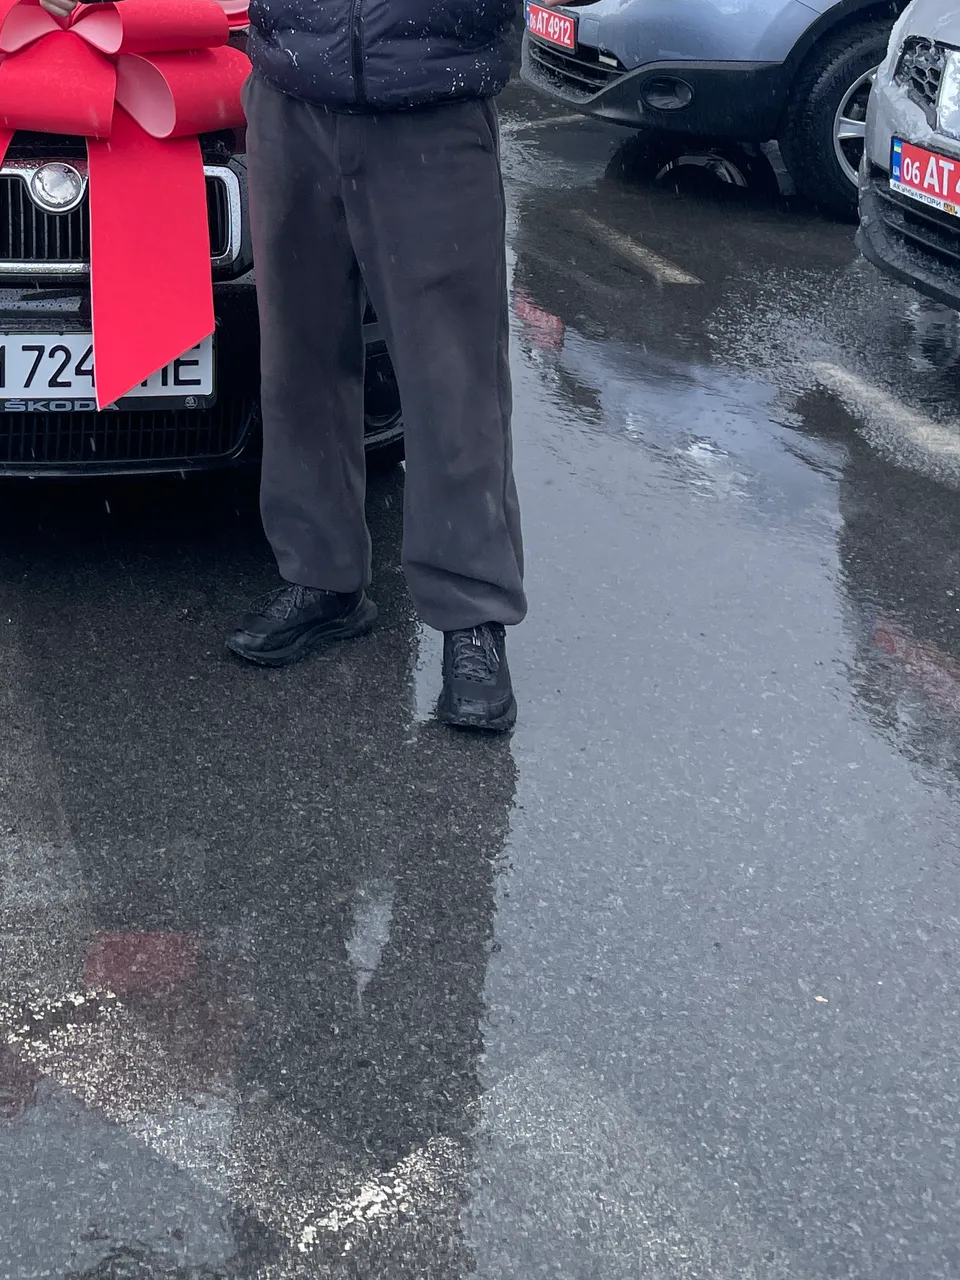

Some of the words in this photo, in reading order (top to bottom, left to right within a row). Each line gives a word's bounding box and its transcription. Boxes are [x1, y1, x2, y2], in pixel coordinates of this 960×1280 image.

[536, 11, 549, 35] AT
[548, 16, 570, 45] 4912
[903, 157, 921, 185] 06
[923, 156, 955, 197] AT
[21, 344, 94, 388] 724
